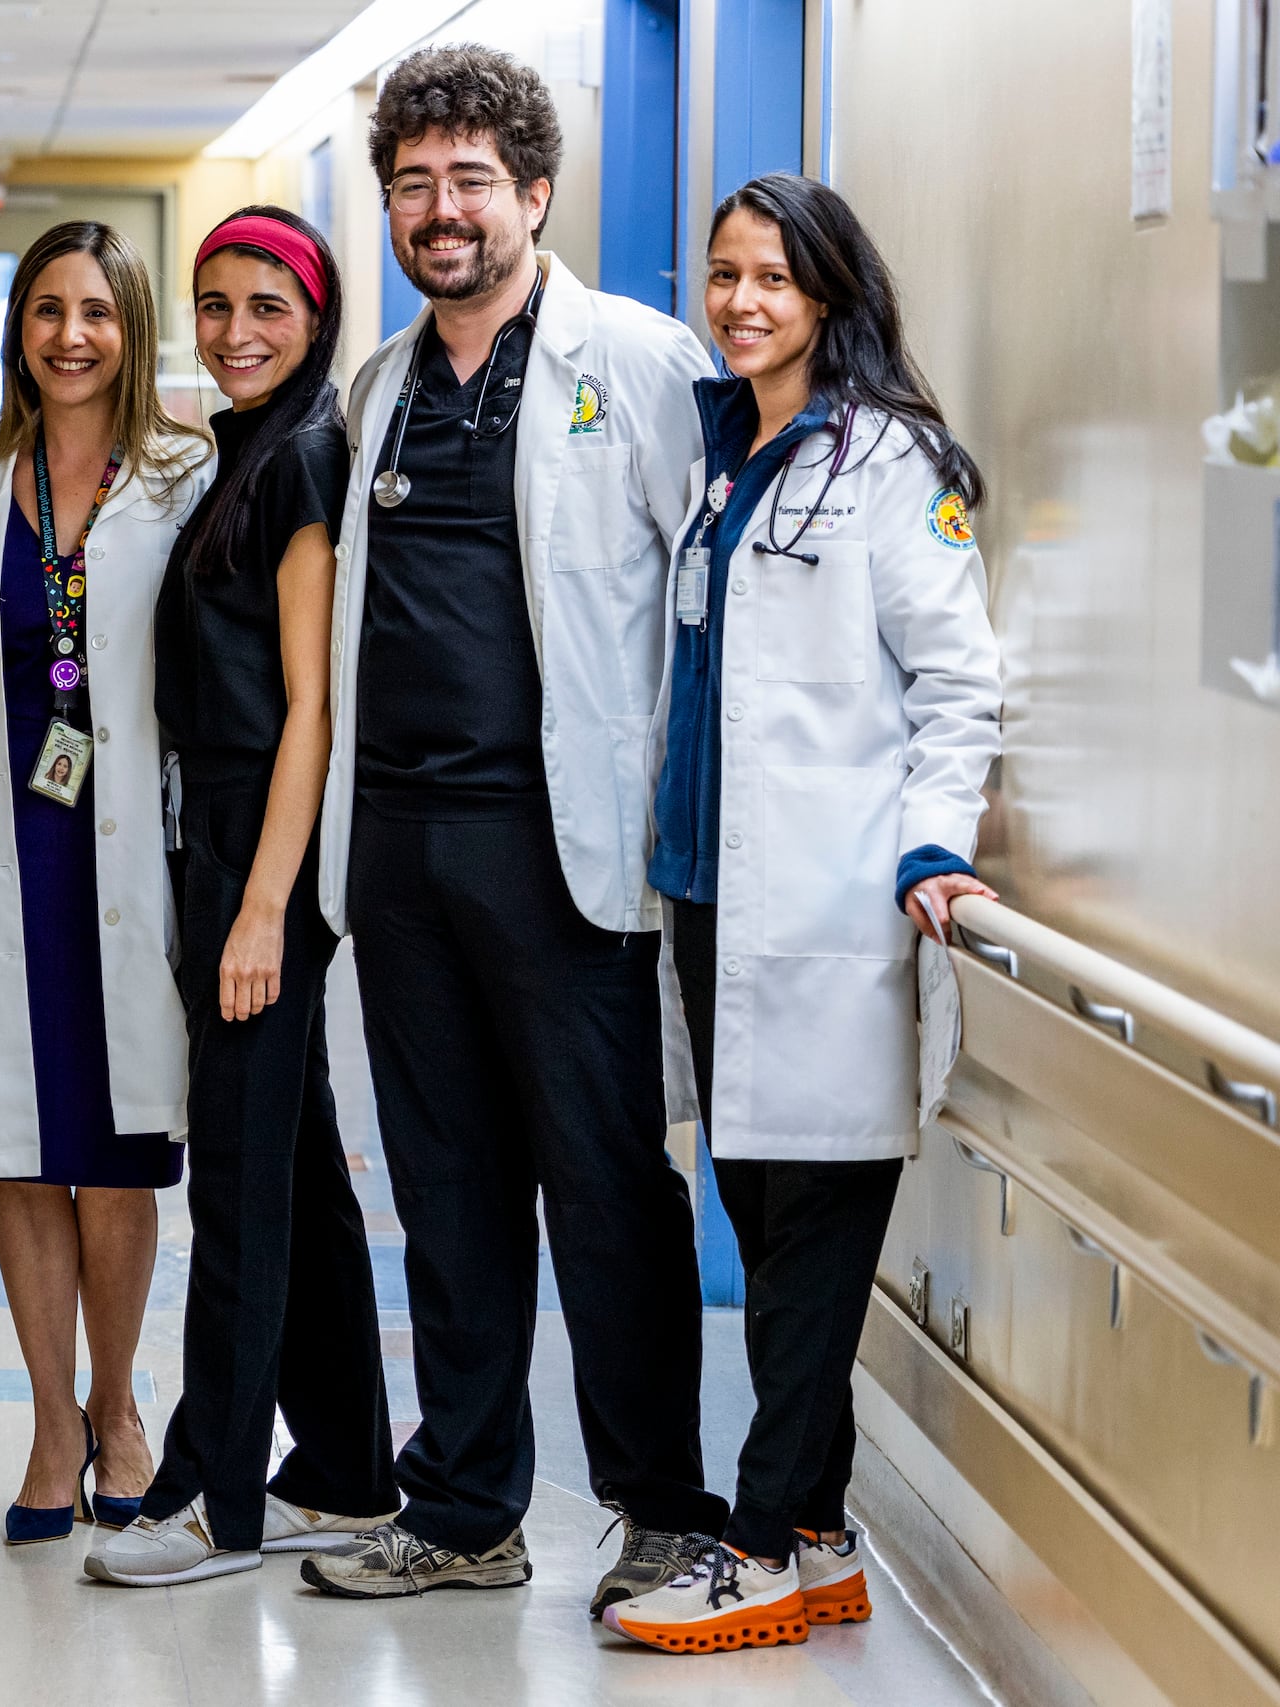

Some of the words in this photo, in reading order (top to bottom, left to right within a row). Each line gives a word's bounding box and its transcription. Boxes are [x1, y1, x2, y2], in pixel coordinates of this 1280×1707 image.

[581, 373, 608, 404] MEDICINA
[38, 477, 52, 514] hospital
[40, 515, 55, 559] pediátrico
